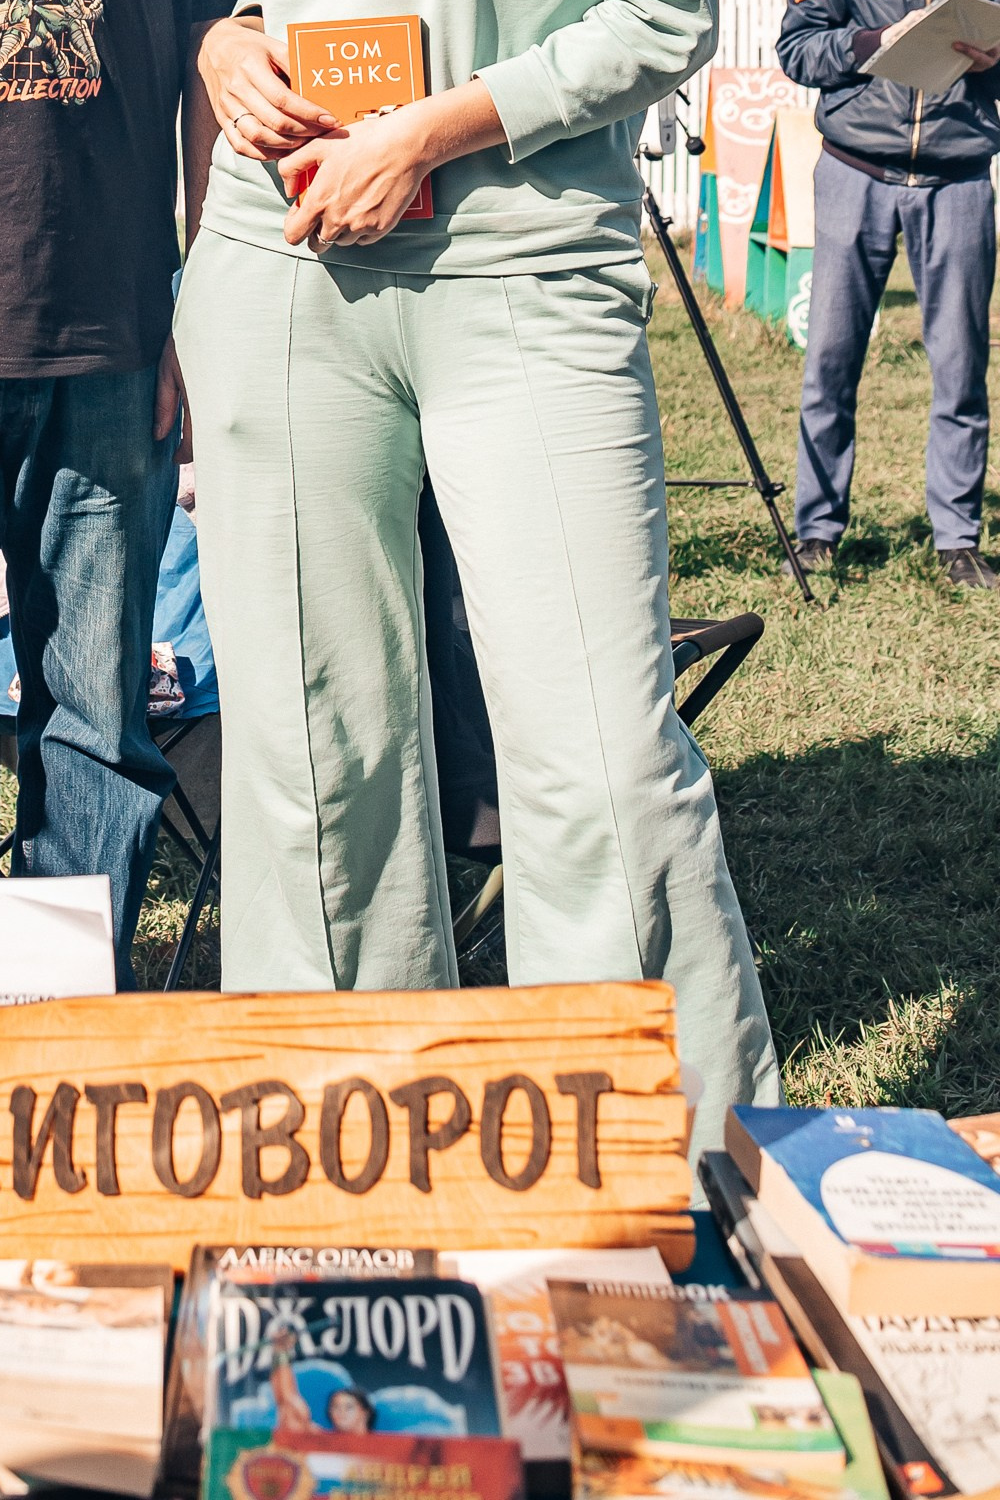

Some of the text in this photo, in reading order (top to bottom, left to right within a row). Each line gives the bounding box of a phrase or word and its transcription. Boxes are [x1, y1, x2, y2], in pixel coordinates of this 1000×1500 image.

[325, 39, 383, 61] ТОМ
[312, 63, 401, 87] ХЭНКС
[219, 1247, 415, 1271] АЛЕКС ОРЛОВ
